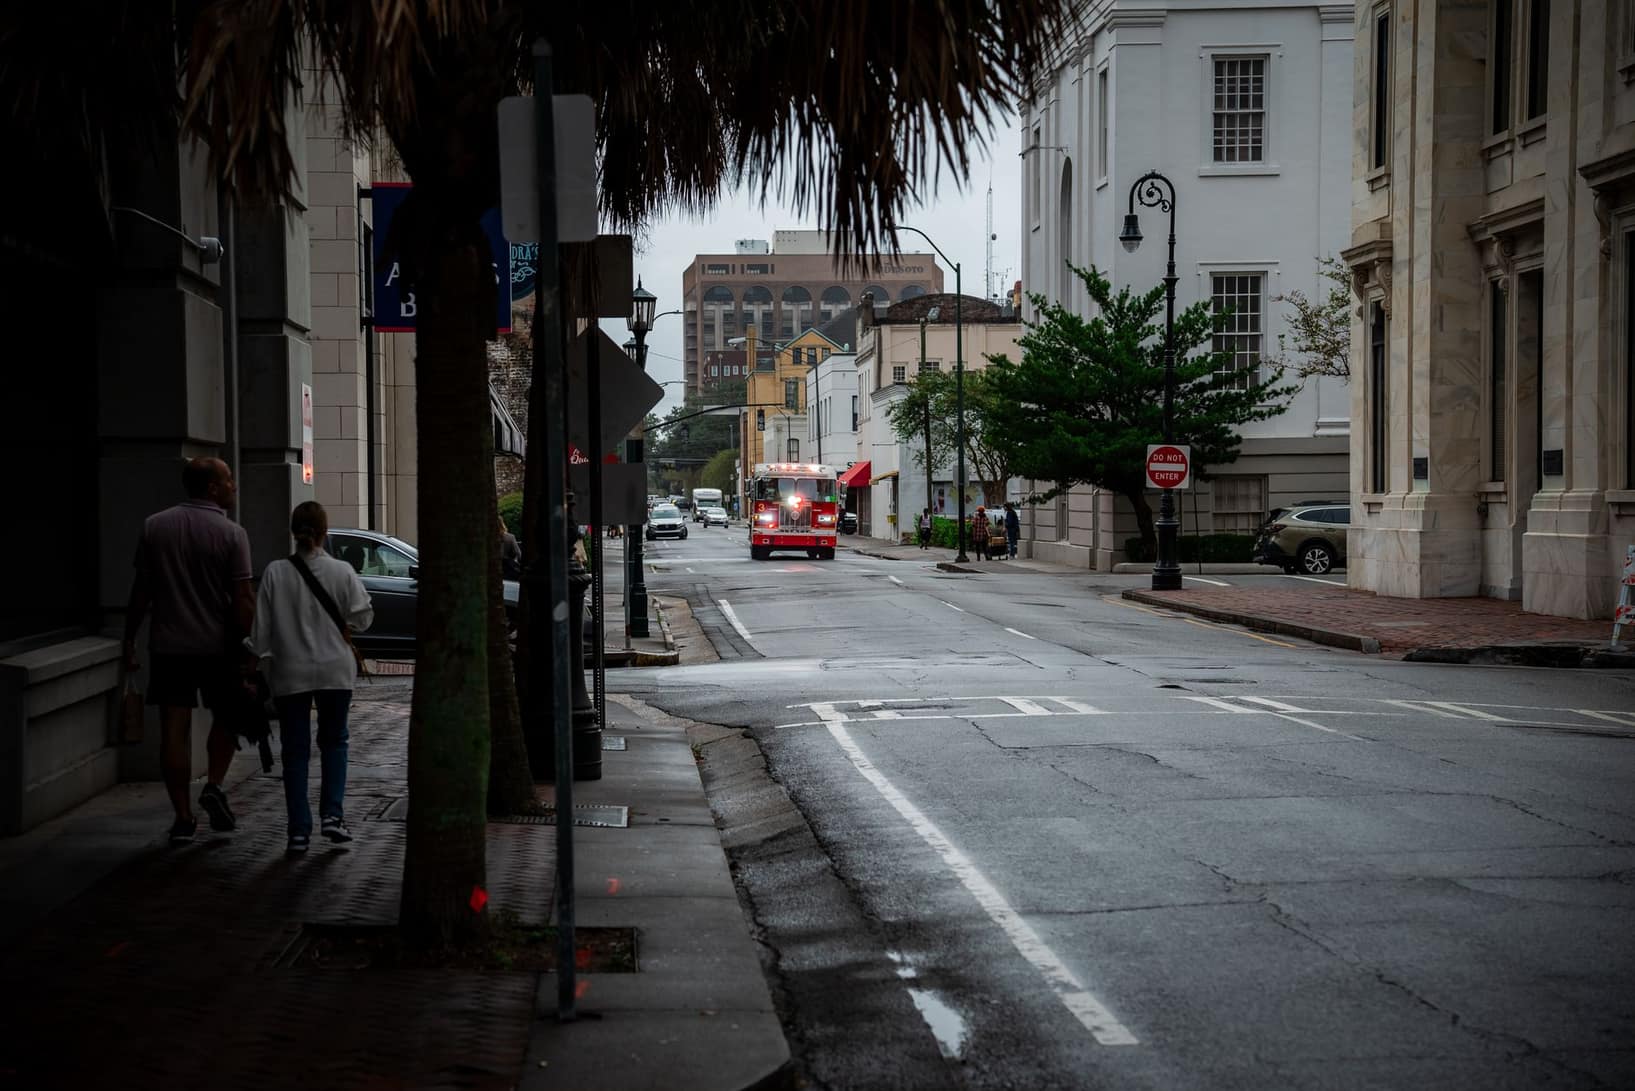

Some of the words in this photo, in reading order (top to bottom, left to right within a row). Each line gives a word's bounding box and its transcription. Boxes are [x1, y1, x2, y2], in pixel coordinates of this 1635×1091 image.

[1166, 454, 1183, 462] NOT
[1155, 472, 1179, 480] ENTER
[758, 503, 766, 512] 3
